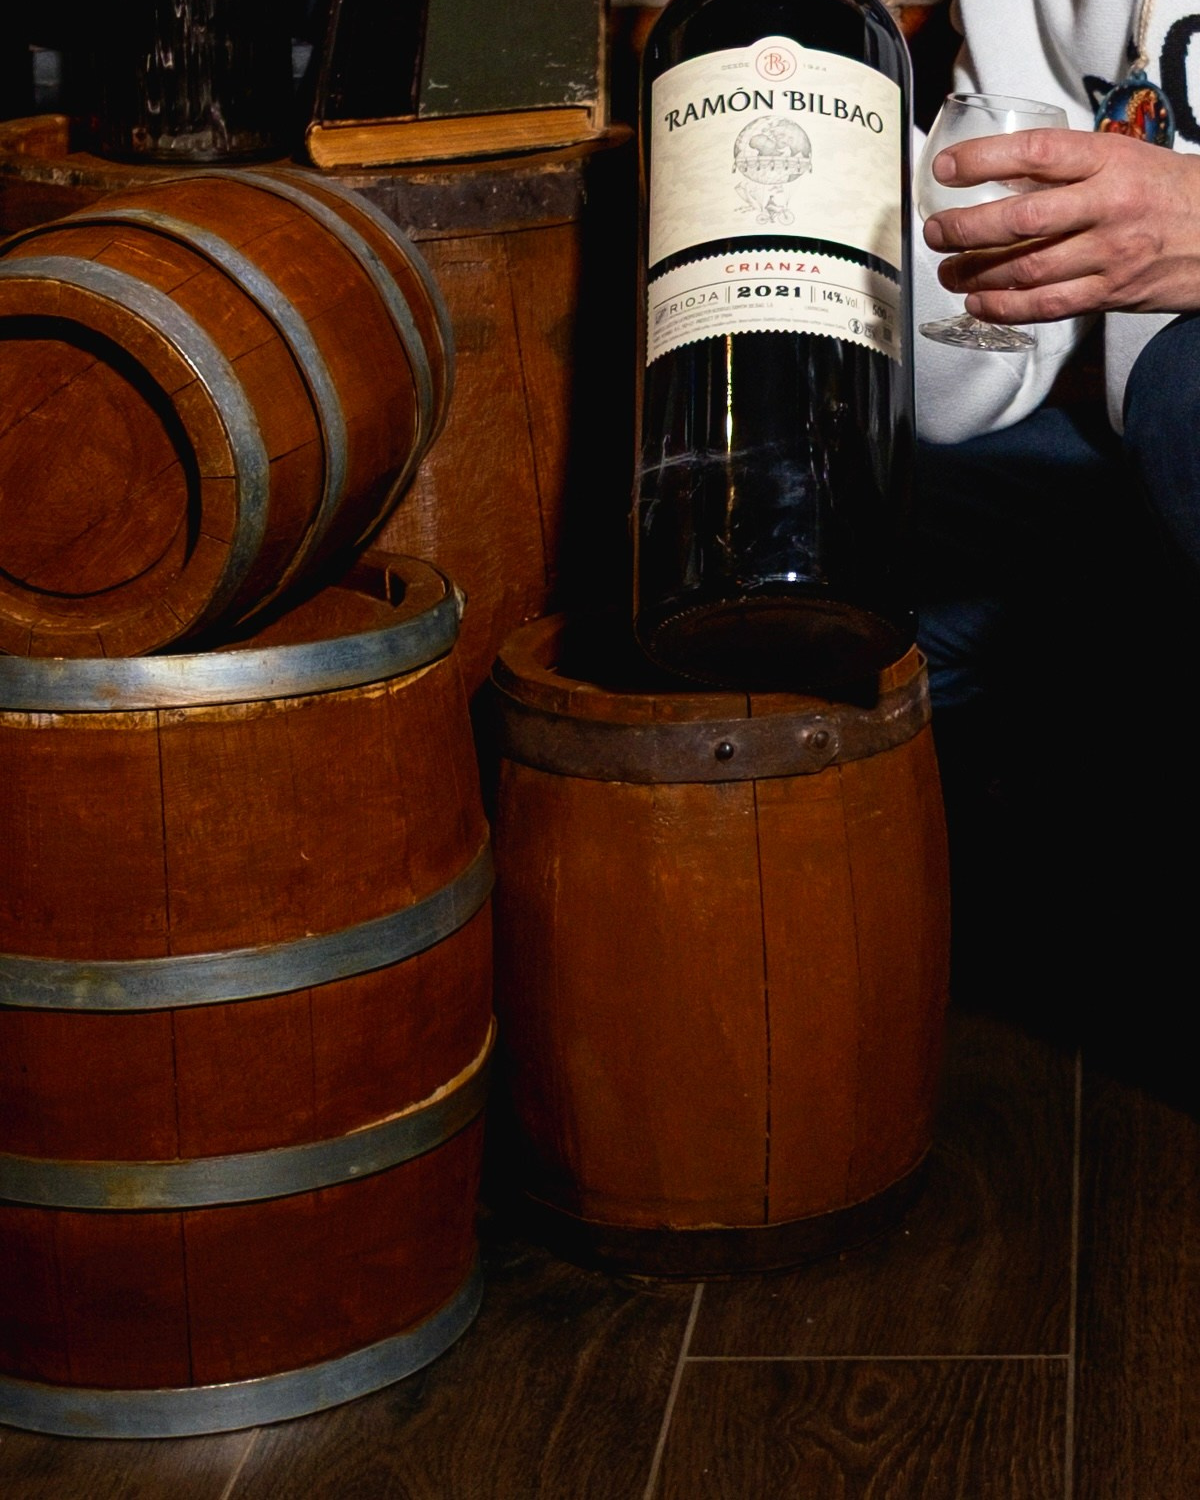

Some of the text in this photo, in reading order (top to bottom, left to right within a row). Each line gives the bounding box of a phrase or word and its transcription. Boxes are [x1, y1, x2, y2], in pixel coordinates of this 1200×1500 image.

[664, 87, 884, 134] RAMÓN BILBAO
[724, 262, 821, 275] CRIANZA
[737, 285, 801, 299] 2021
[822, 290, 843, 304] 14%
[669, 291, 719, 314] RIOJA
